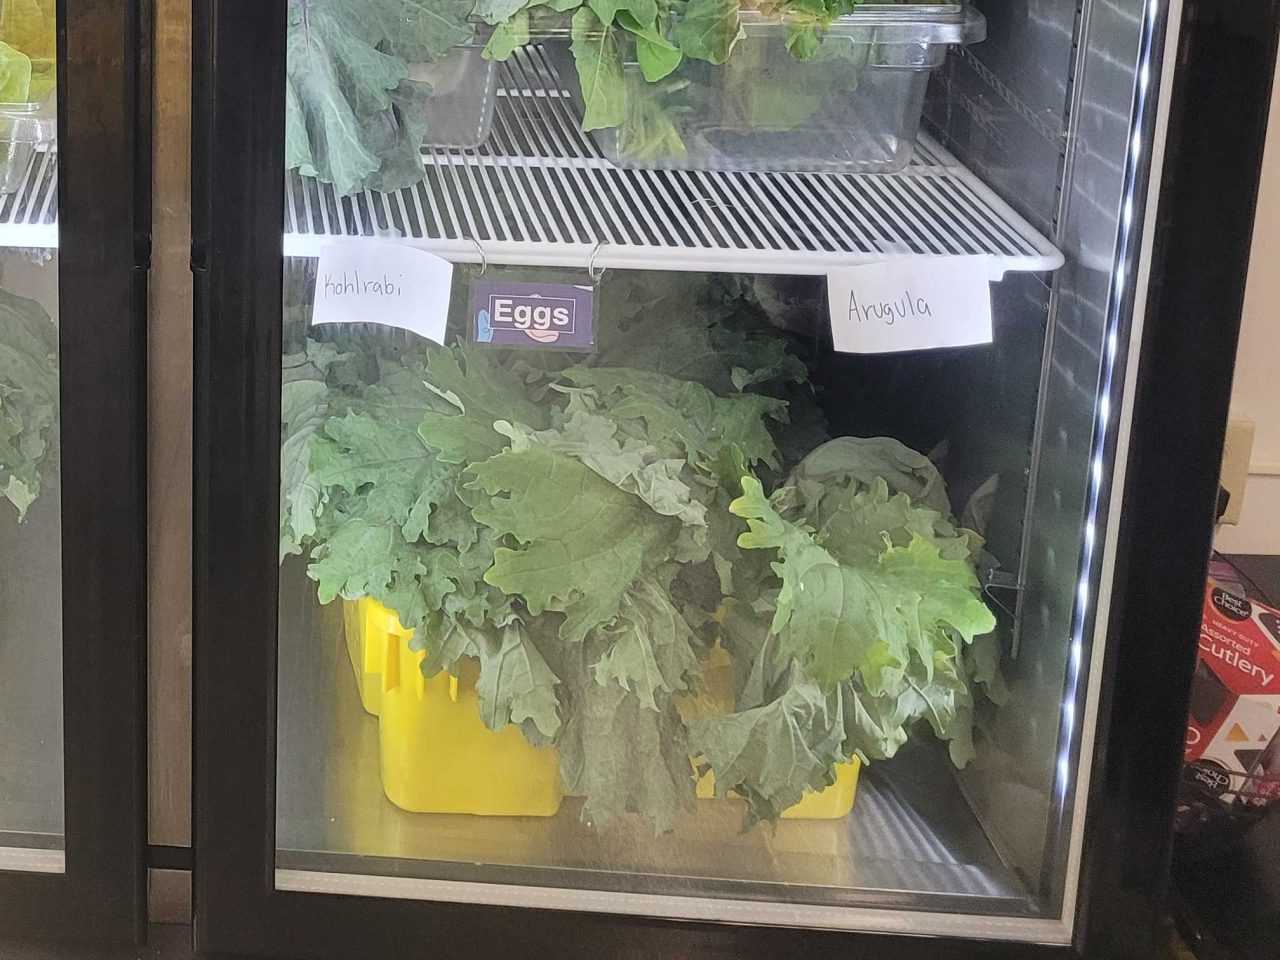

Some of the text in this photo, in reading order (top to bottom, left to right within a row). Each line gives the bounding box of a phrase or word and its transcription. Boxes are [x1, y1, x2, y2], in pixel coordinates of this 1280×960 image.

[494, 298, 570, 330] Eggs
[848, 289, 932, 326] Arugula
[1200, 623, 1251, 656] Assorted
[1198, 632, 1275, 686] Cutlery
